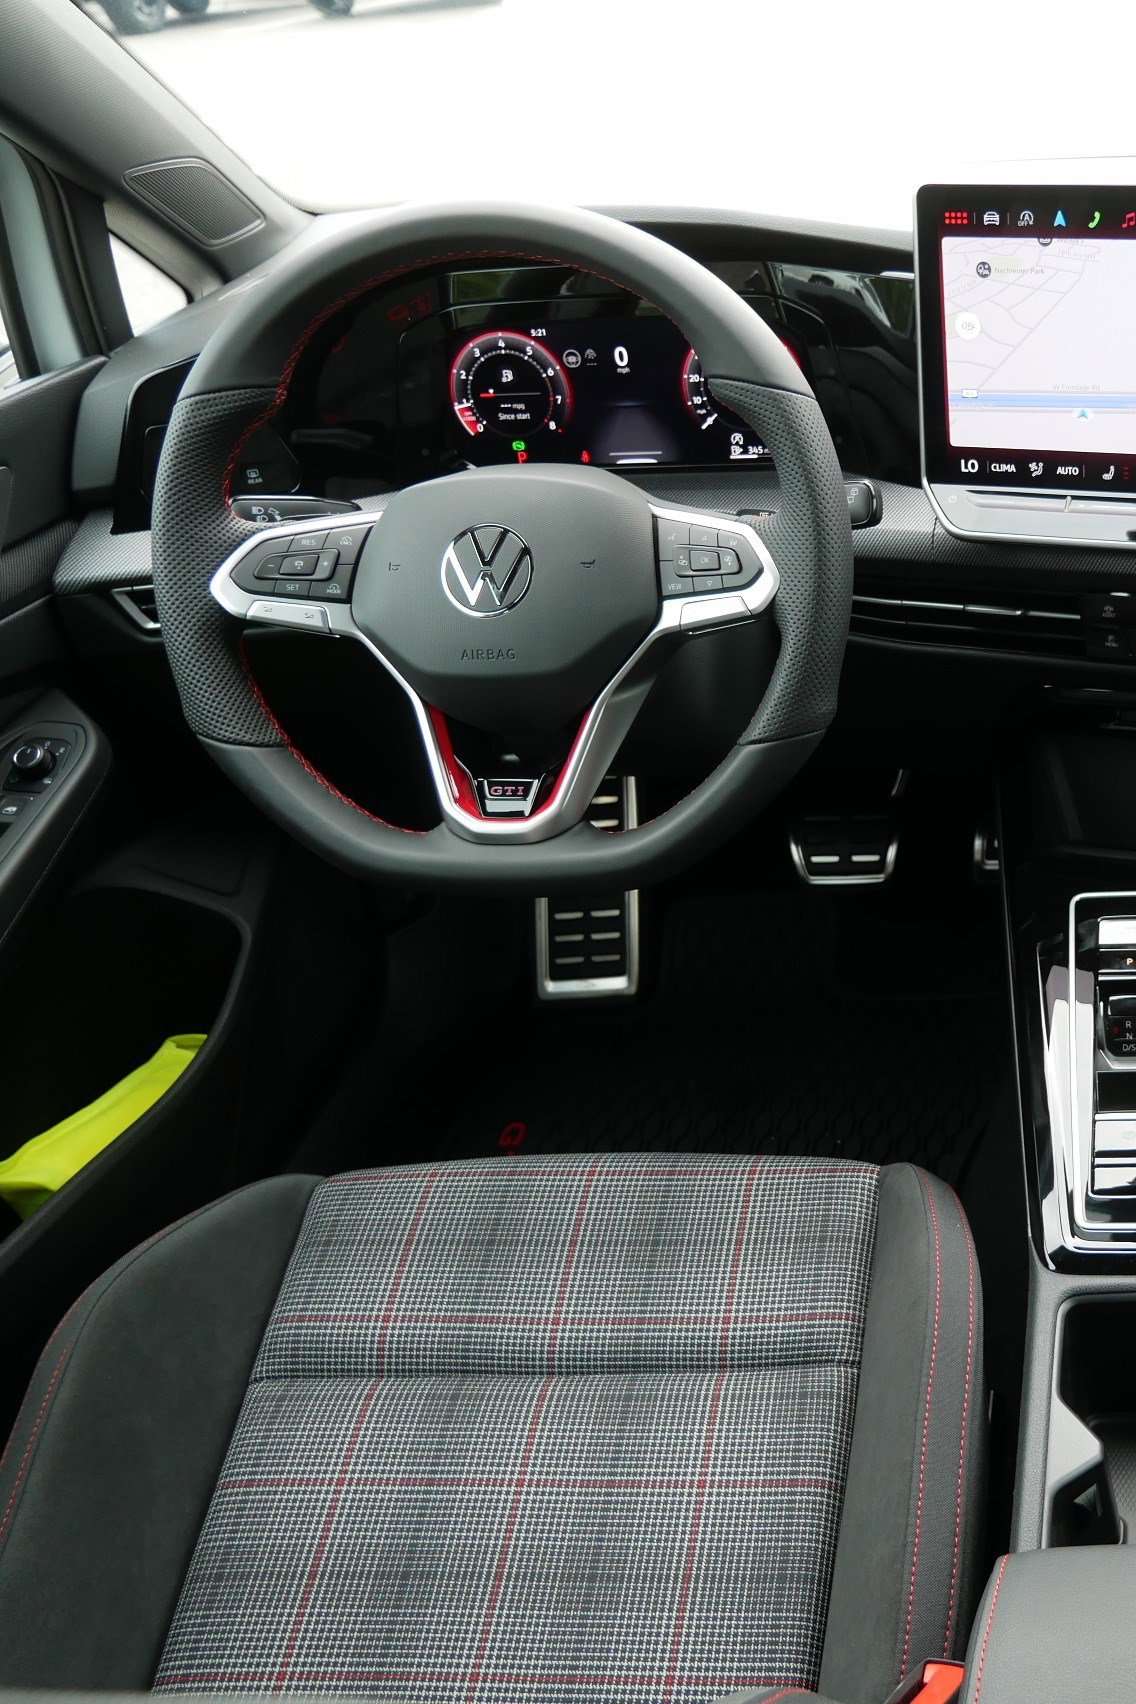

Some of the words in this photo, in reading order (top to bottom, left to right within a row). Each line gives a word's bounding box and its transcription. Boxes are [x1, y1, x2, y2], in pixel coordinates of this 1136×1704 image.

[1030, 267, 1046, 276] Park
[530, 328, 546, 337] 5:21
[498, 339, 505, 348] 4
[474, 348, 480, 357] 3
[525, 346, 533, 355] 5
[613, 346, 629, 367] 0
[460, 371, 467, 379] 2
[547, 368, 554, 377] 6
[1061, 384, 1090, 392] Frontage
[555, 395, 562, 404] 7
[692, 396, 702, 404] 10
[498, 412, 515, 421] Since
[476, 423, 484, 432] 0
[549, 421, 557, 430] 8
[747, 446, 764, 454] 345
[517, 450, 529, 464] P
[960, 459, 979, 473] LO
[990, 462, 1017, 473] CLIMA
[1056, 465, 1079, 476] AUTO
[301, 538, 316, 546] RES
[460, 648, 516, 660] AIRBAG
[490, 786, 525, 796] GTI
[1126, 957, 1135, 965] P
[1125, 1020, 1132, 1028] R
[1126, 1032, 1133, 1040] N
[1122, 1043, 1136, 1051] D/S
